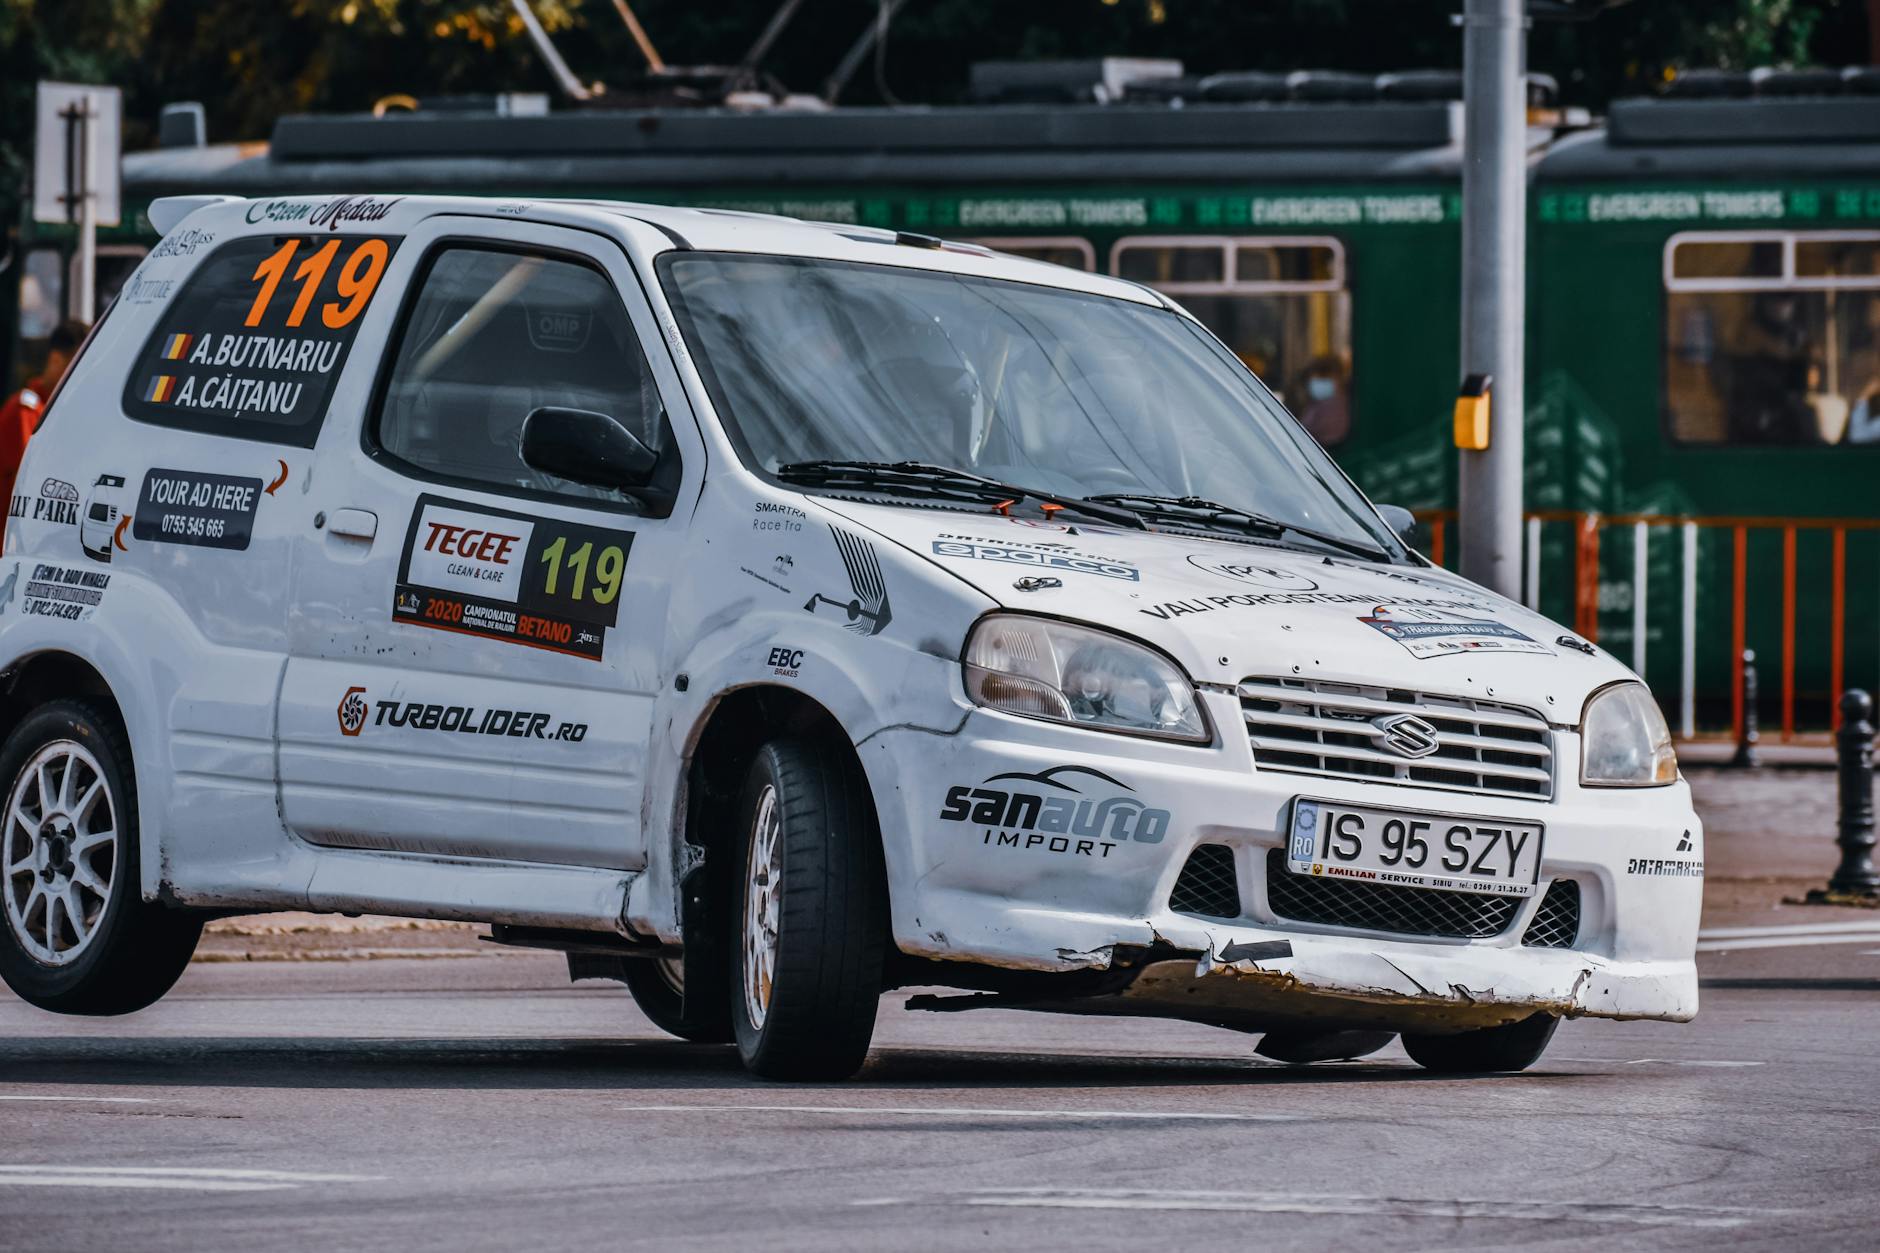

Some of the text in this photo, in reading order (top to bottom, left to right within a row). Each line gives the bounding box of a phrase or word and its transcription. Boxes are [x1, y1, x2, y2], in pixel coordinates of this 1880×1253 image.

[309, 197, 405, 231] Medical
[1364, 195, 1444, 223] TOWERS
[1703, 191, 1784, 219] TOWERS
[244, 238, 389, 329] 119
[539, 316, 580, 337] OMP
[189, 333, 342, 374] A.BUTNARIU
[149, 477, 254, 512] YOUR AD HERE
[33, 497, 80, 526] PARK
[755, 502, 806, 519] SMARTRA
[161, 514, 225, 538] 0755 545 665
[752, 518, 781, 532] Race
[424, 521, 521, 565] TEGEE
[447, 563, 504, 583] CLEAN & CARE
[541, 536, 625, 605] 119
[937, 541, 1135, 579] sparco
[425, 597, 464, 623] 2020
[464, 604, 517, 624] CAMPIONATUL
[1138, 597, 1216, 620] VALI
[487, 620, 496, 630] DE
[517, 614, 572, 644] BETANO
[767, 647, 805, 669] EBC
[774, 667, 799, 678] BRAKES
[375, 700, 588, 742] TURBOLIDER.RO
[940, 785, 1172, 845] sanauto
[983, 829, 1117, 858] IMPORT
[1293, 836, 1314, 856] RO
[1320, 810, 1530, 878] IS 95 SZY
[1327, 866, 1377, 880] EMILIAN
[1380, 872, 1425, 885] SERVICE
[1432, 879, 1453, 888] SIBIU
[1473, 882, 1492, 891] 0269
